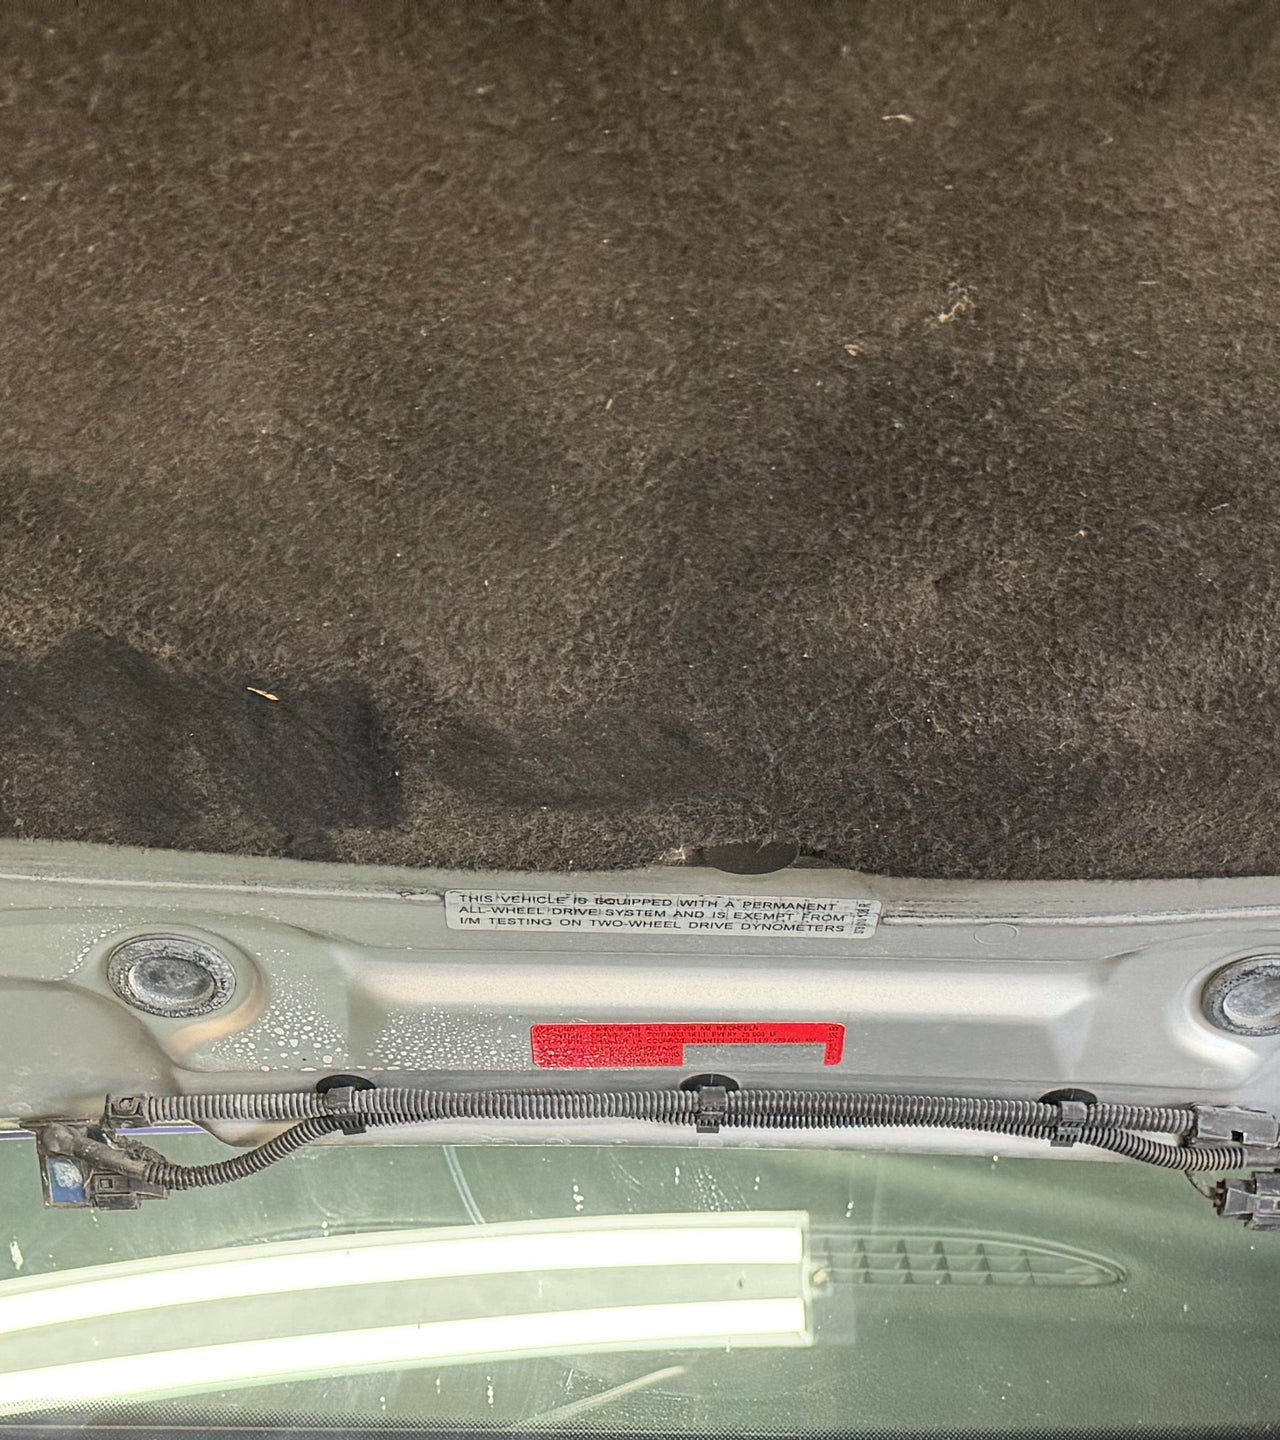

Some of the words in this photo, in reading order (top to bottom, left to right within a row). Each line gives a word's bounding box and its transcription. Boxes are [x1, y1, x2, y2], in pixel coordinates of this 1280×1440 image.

[459, 895, 493, 903] THIS
[501, 895, 567, 904] VEHICLE
[595, 897, 673, 908] EQUIPPED
[679, 899, 718, 908] WITH
[724, 900, 735, 908] A
[742, 900, 838, 911] PERMANENT
[459, 905, 543, 915] ALL-WHEEL
[552, 907, 598, 916] DRIVE
[605, 908, 667, 918] SYSTEM
[673, 910, 705, 919] AND
[712, 911, 726, 920] IS
[733, 911, 794, 921] EXEMPT
[801, 912, 846, 922] FROM
[460, 917, 481, 925] I/M
[489, 917, 553, 926] TESTING
[559, 918, 582, 927] ON
[590, 919, 682, 929] TWO-WHEEL
[688, 921, 734, 930] DRIVE
[739, 922, 846, 933] DYNOMETERS
